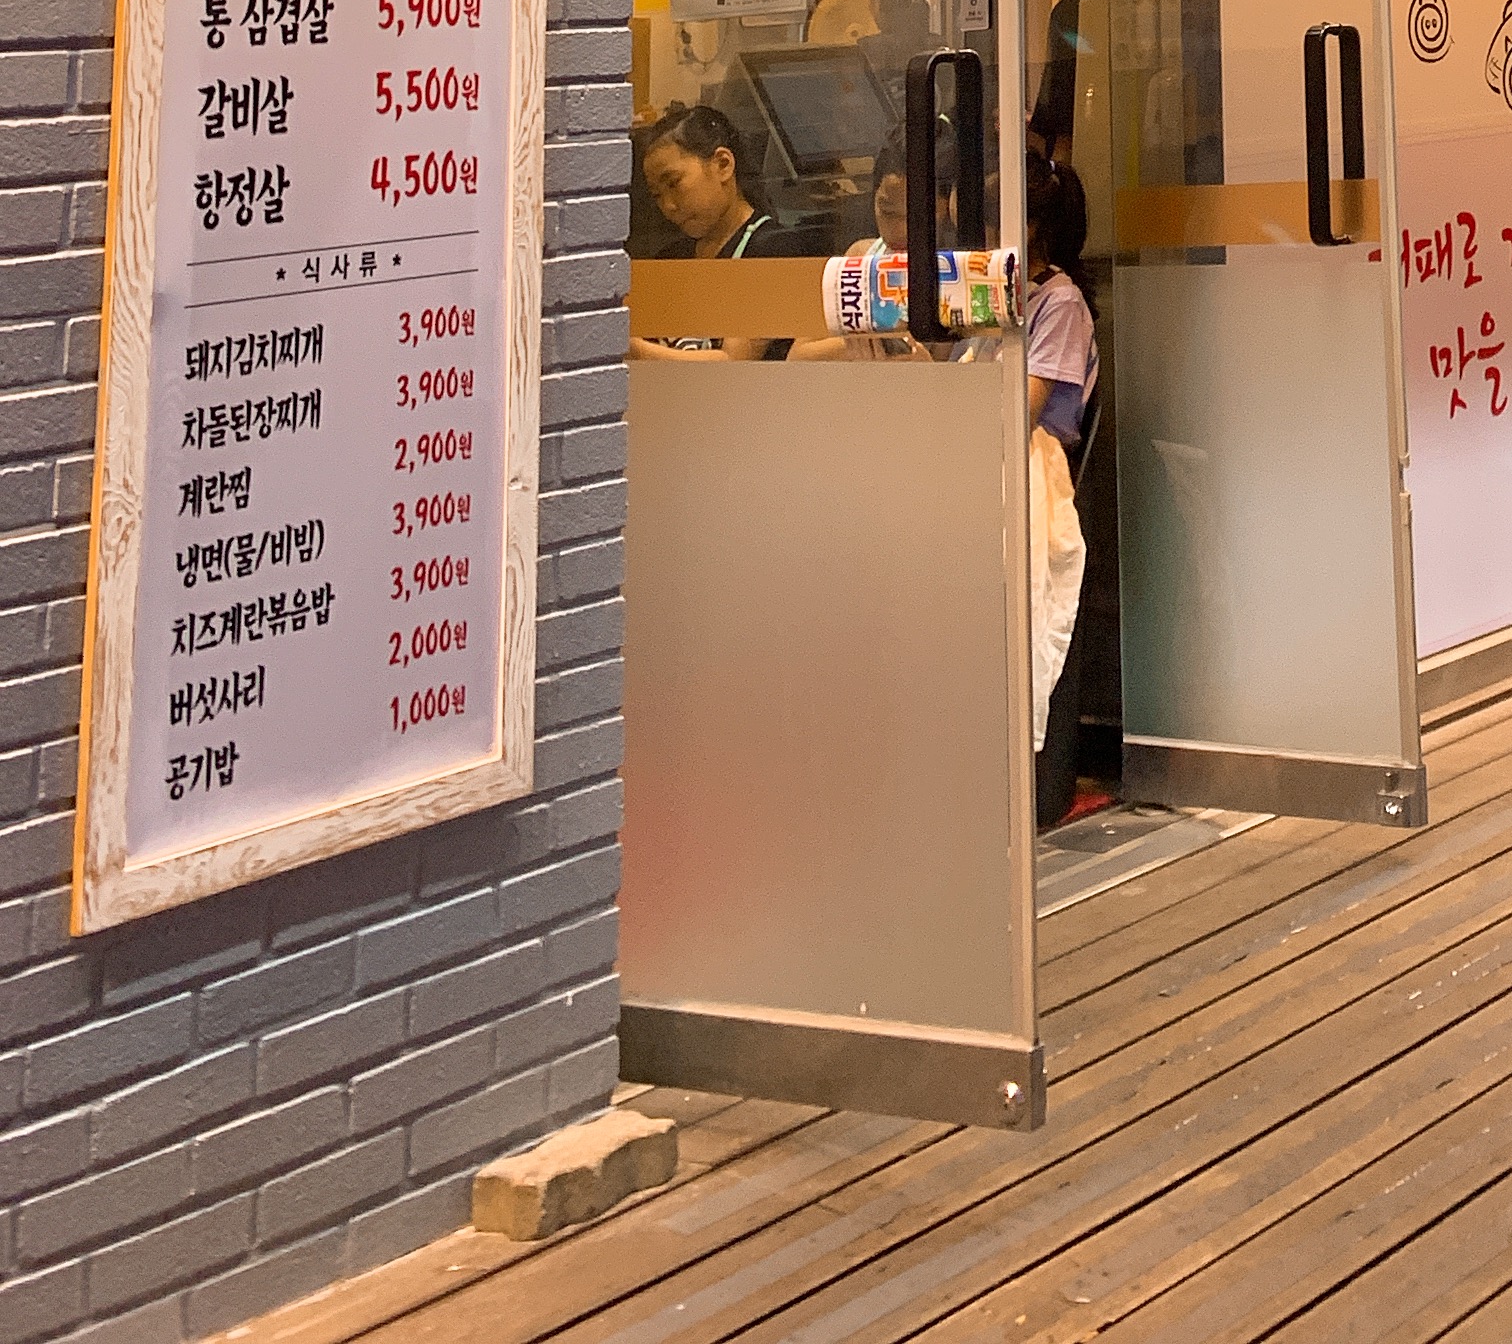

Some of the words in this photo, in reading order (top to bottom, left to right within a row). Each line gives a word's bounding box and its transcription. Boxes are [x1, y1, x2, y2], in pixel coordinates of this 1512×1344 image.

[199, 76, 294, 139] 갈비살
[377, 67, 479, 118] 5,500원
[194, 165, 290, 230] 항정살
[371, 150, 478, 202] 4,500원
[301, 251, 378, 283] 식사류
[185, 324, 323, 381] 돼지김치찌개
[400, 306, 475, 346] 3,900원
[1430, 312, 1508, 418] 맛을
[182, 389, 321, 449] 차돌된장찌개
[399, 368, 474, 407] 3,900원
[179, 467, 251, 517] 계란찜
[396, 429, 472, 471] 2,900원
[176, 519, 325, 588] 냉면(물/비빔)
[394, 492, 471, 536] 3,900원
[170, 582, 336, 657] 치즈계란볶음밥
[392, 555, 469, 599] 3,900원
[170, 665, 265, 725] 버섯사리
[389, 619, 467, 665] 2,000원
[165, 741, 239, 800] 공기밥
[391, 684, 466, 732] 1,000원
